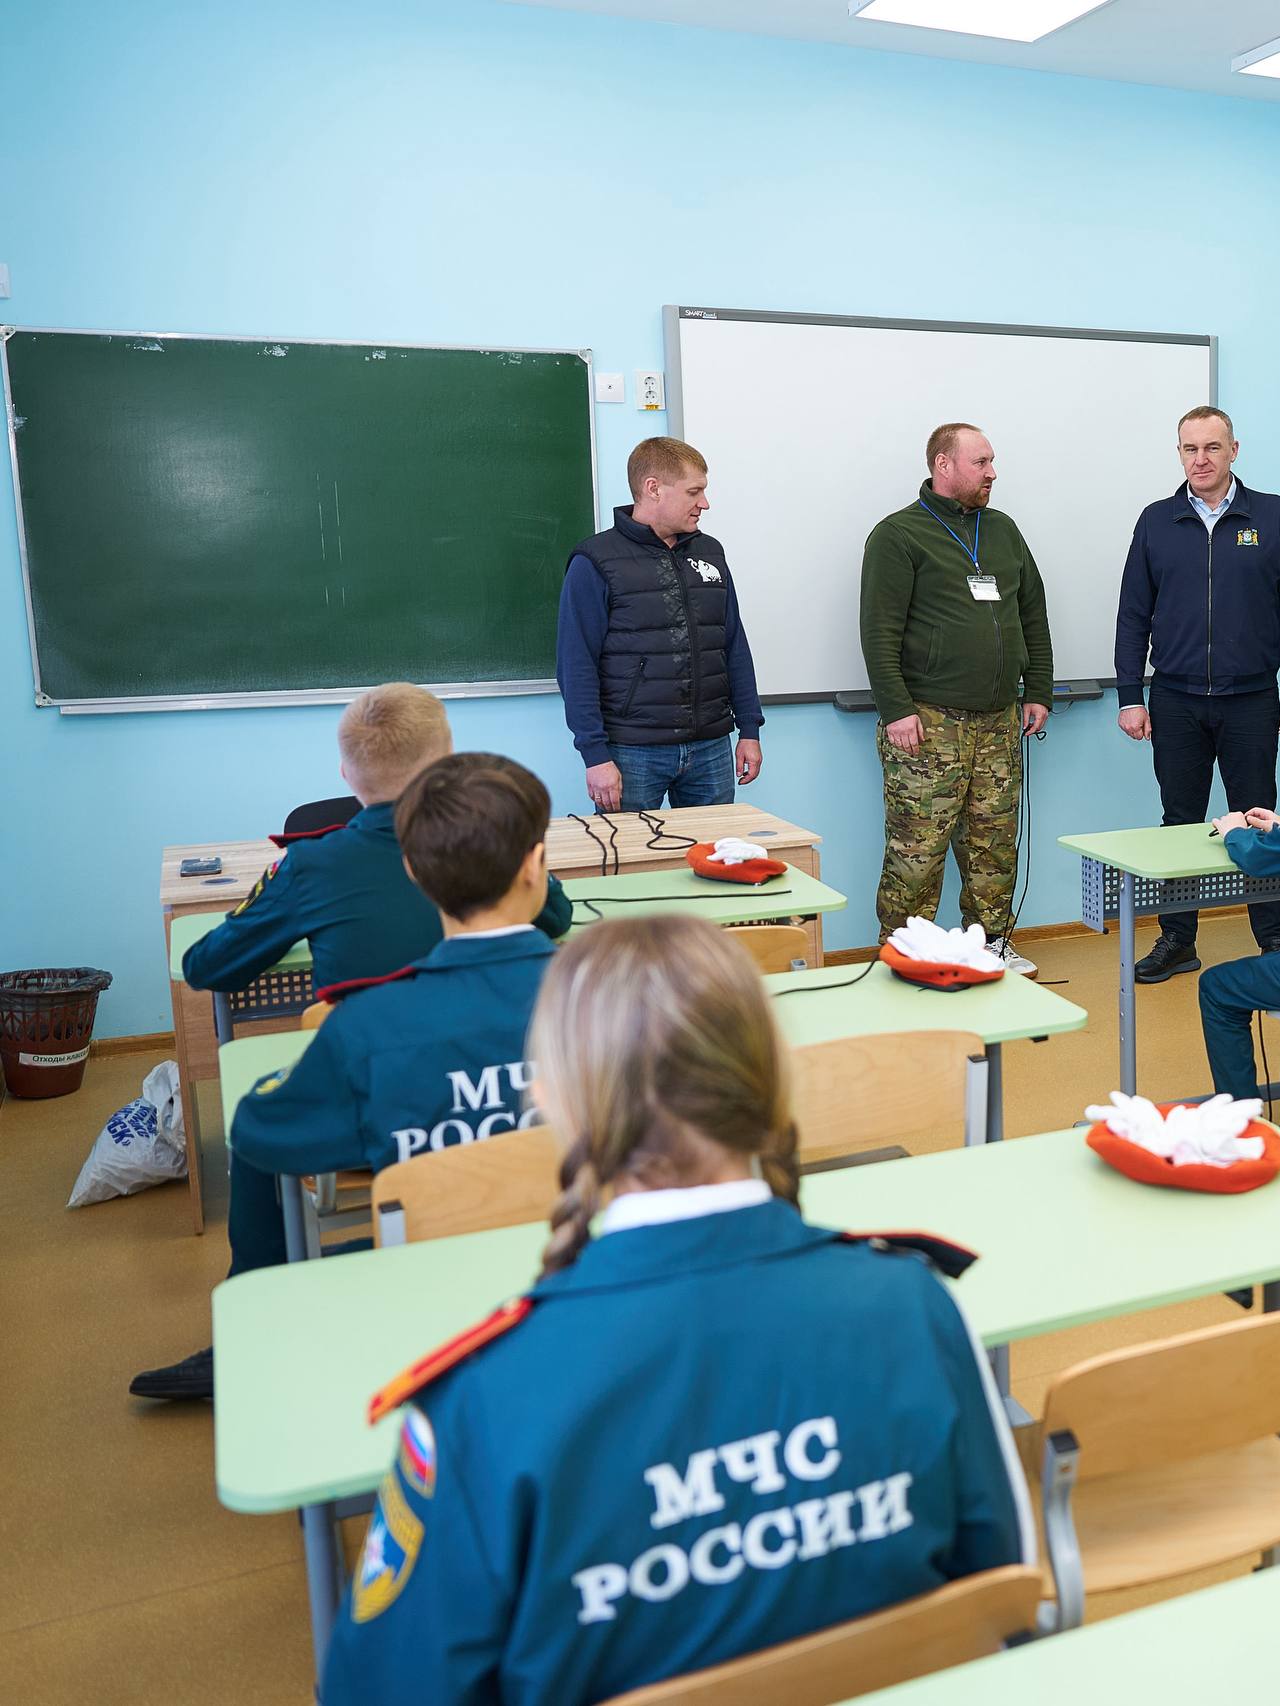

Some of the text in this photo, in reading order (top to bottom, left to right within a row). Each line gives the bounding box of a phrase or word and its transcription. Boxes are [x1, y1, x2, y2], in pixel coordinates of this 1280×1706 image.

[32, 1055, 65, 1064] Отходы
[446, 1060, 538, 1114] МЧ
[643, 1416, 842, 1529] МЧС
[572, 1472, 914, 1625] РОССИИ
